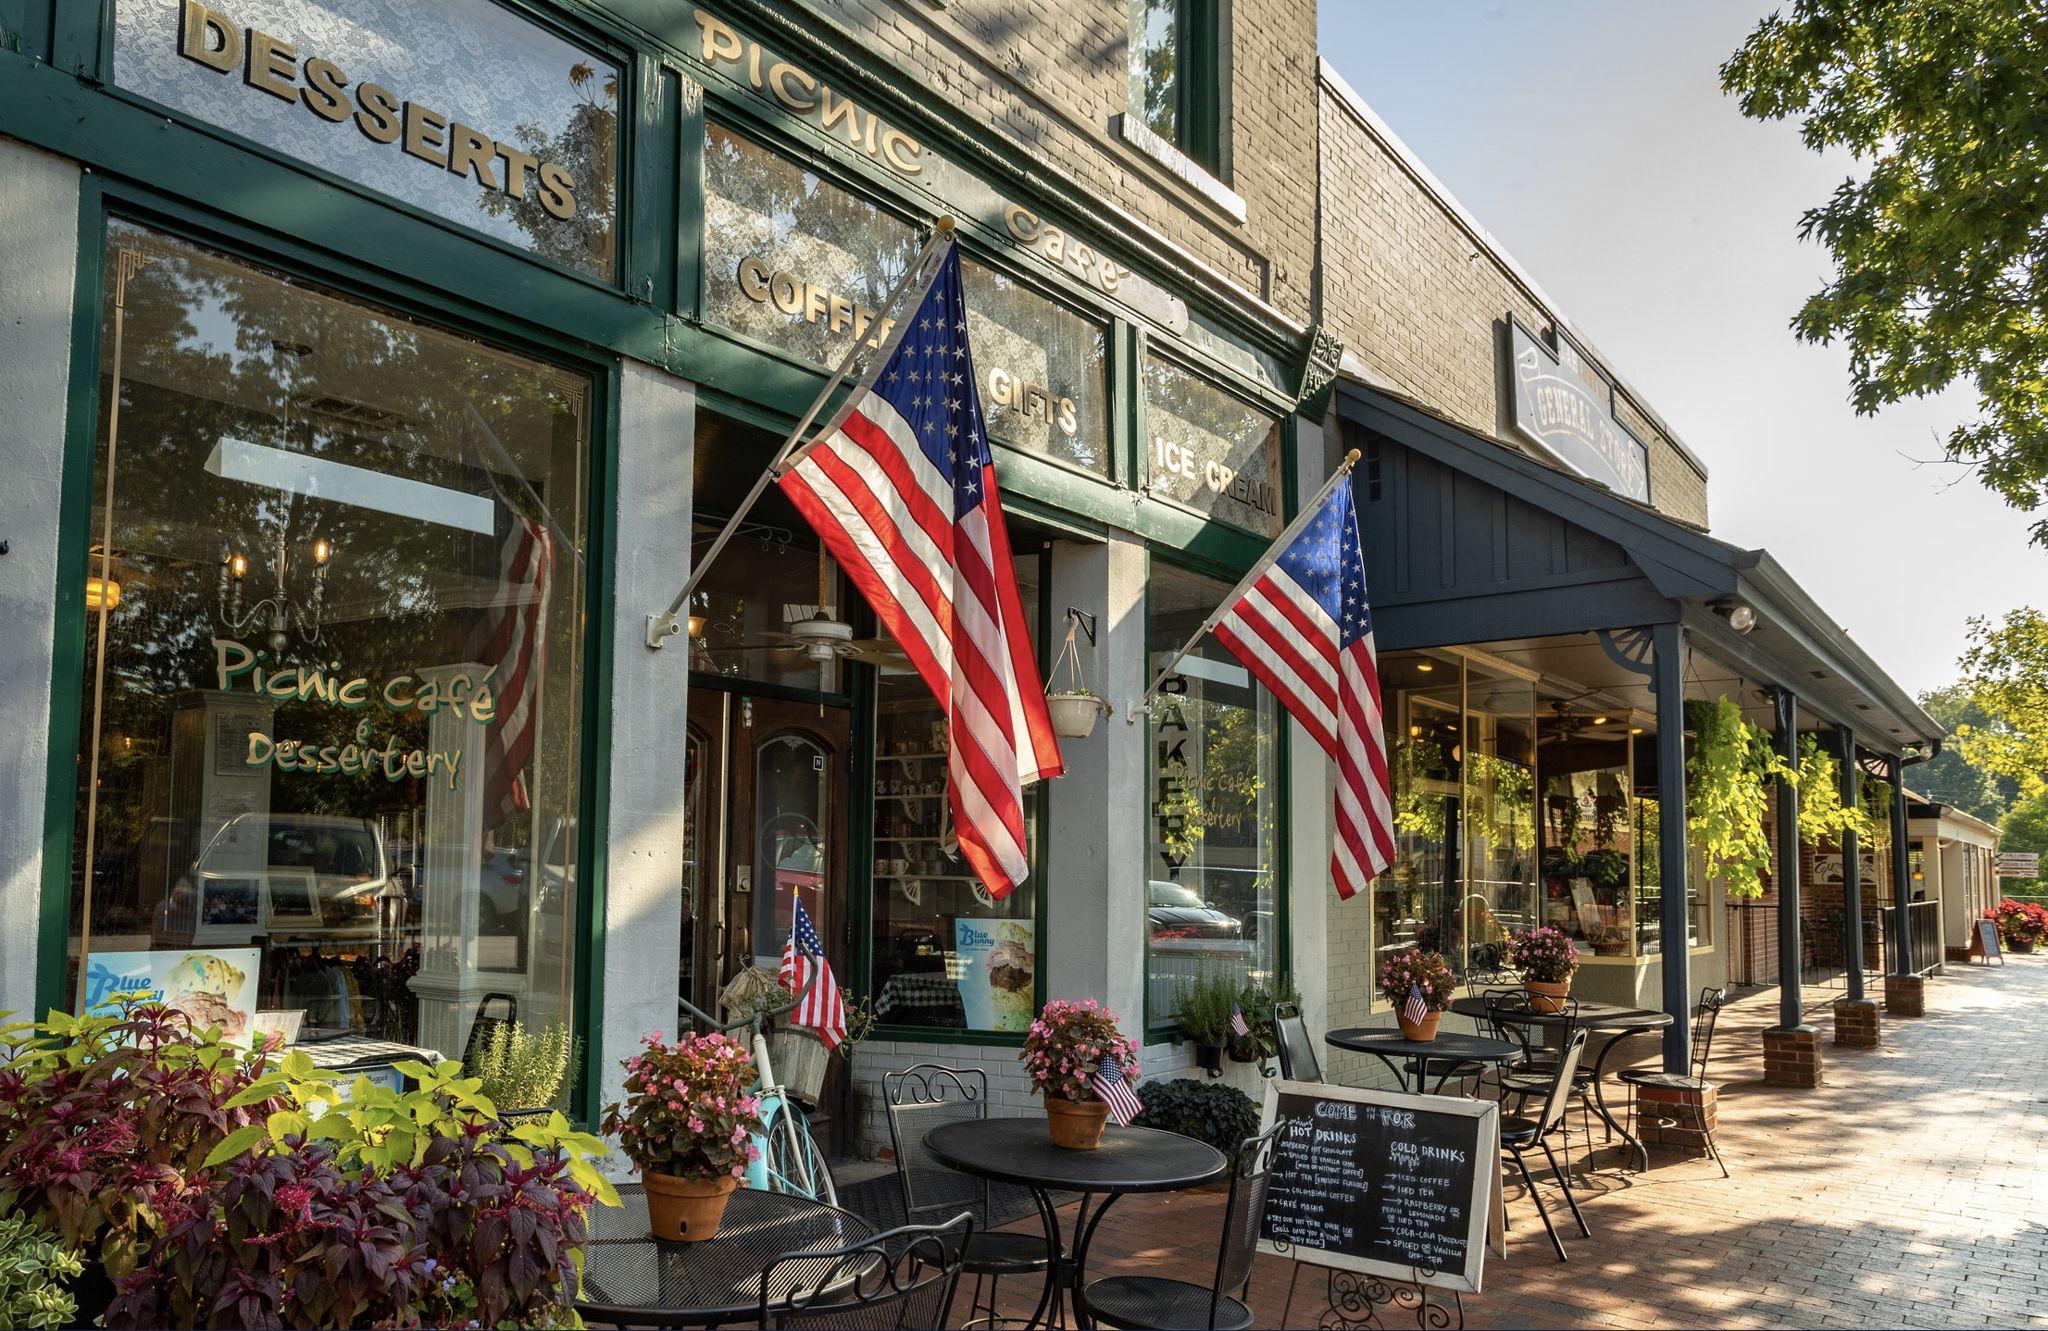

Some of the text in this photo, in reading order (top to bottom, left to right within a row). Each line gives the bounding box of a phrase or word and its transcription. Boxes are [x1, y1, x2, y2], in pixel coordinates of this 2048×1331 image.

[693, 9, 922, 175] PICNIC
[178, 0, 577, 221] DESSERTS
[989, 367, 1077, 437] GIFTS
[1536, 385, 1594, 440] GENERAL
[1155, 437, 1276, 516] ICE CREAM
[212, 639, 367, 709] Picnic
[246, 731, 463, 790] Dessertery
[1158, 668, 1190, 881] BAKERY
[1174, 761, 1215, 791] Picnic
[1315, 1102, 1357, 1120] COME
[1380, 1108, 1416, 1129] FOR
[1290, 1126, 1357, 1144] HOT DRINKS
[1289, 1152, 1308, 1161] SPICED
[1318, 1157, 1340, 1166] VANILLA
[1322, 1147, 1354, 1156] CHOCOLATE
[1391, 1141, 1465, 1163] COLD DRINKS
[1285, 1170, 1298, 1179] HOT
[1301, 1173, 1313, 1181] TEA
[1398, 1174, 1451, 1187] ICED COFFEE
[1291, 1186, 1356, 1203] COLOMBIAN COFFEE
[1397, 1185, 1435, 1197] ICED TEA
[1300, 1203, 1324, 1213] MOCHA
[1382, 1206, 1447, 1223] PEACH LEMONADE
[1404, 1198, 1461, 1218] RASPBERRY OR
[1324, 1223, 1339, 1231] OVER
[1398, 1217, 1413, 1225] ICED
[1415, 1219, 1430, 1228] TEA
[1307, 1229, 1318, 1238] YOU
[1396, 1227, 1436, 1240] COCA-COLA
[1393, 1239, 1419, 1251] SPICED
[1433, 1245, 1462, 1257] VANILLA
